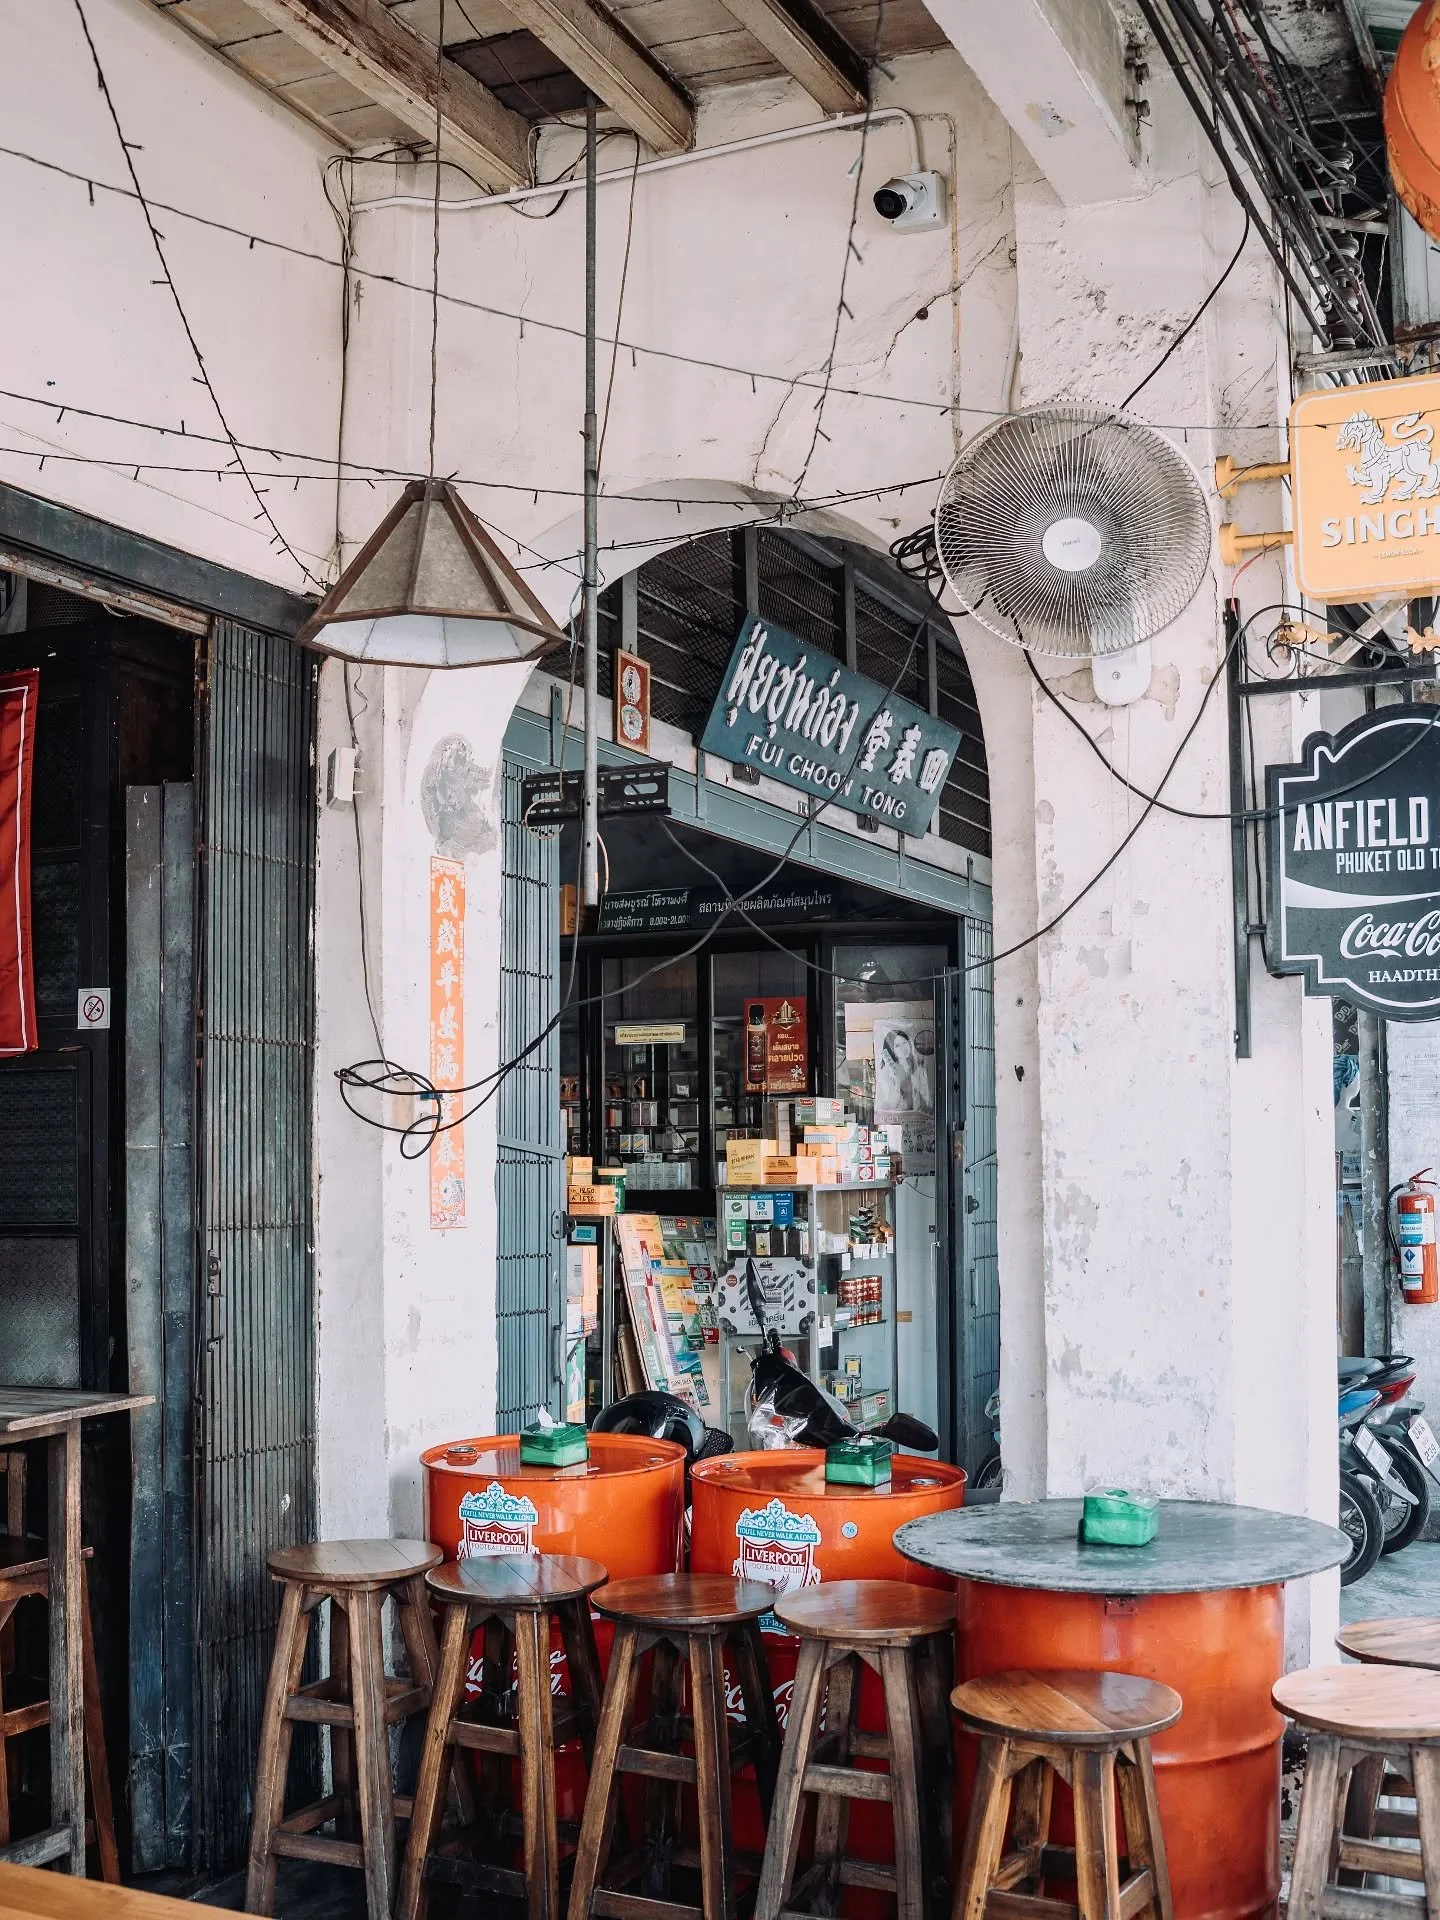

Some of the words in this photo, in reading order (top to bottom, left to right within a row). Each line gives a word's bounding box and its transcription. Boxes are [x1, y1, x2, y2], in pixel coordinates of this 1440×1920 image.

[745, 734, 785, 768] FUI
[788, 753, 854, 797] CHOON
[862, 786, 907, 819] TONG
[1293, 796, 1430, 852] ANFIELD
[1336, 850, 1392, 875] PHUKET
[1397, 848, 1425, 871] OLD
[478, 1511, 496, 1519] NEVER
[496, 1513, 513, 1521] WALK
[469, 1529, 524, 1545] LIVERPOOL
[756, 1529, 775, 1538] NEVER
[775, 1532, 794, 1540] WALK
[794, 1533, 816, 1541] ALONE
[471, 1543, 503, 1551] FOOTBALL
[504, 1545, 522, 1553] CLUB
[746, 1547, 805, 1565] LIVERPOOL
[748, 1562, 782, 1572] FOOTBALL
[783, 1565, 802, 1574] CLUB
